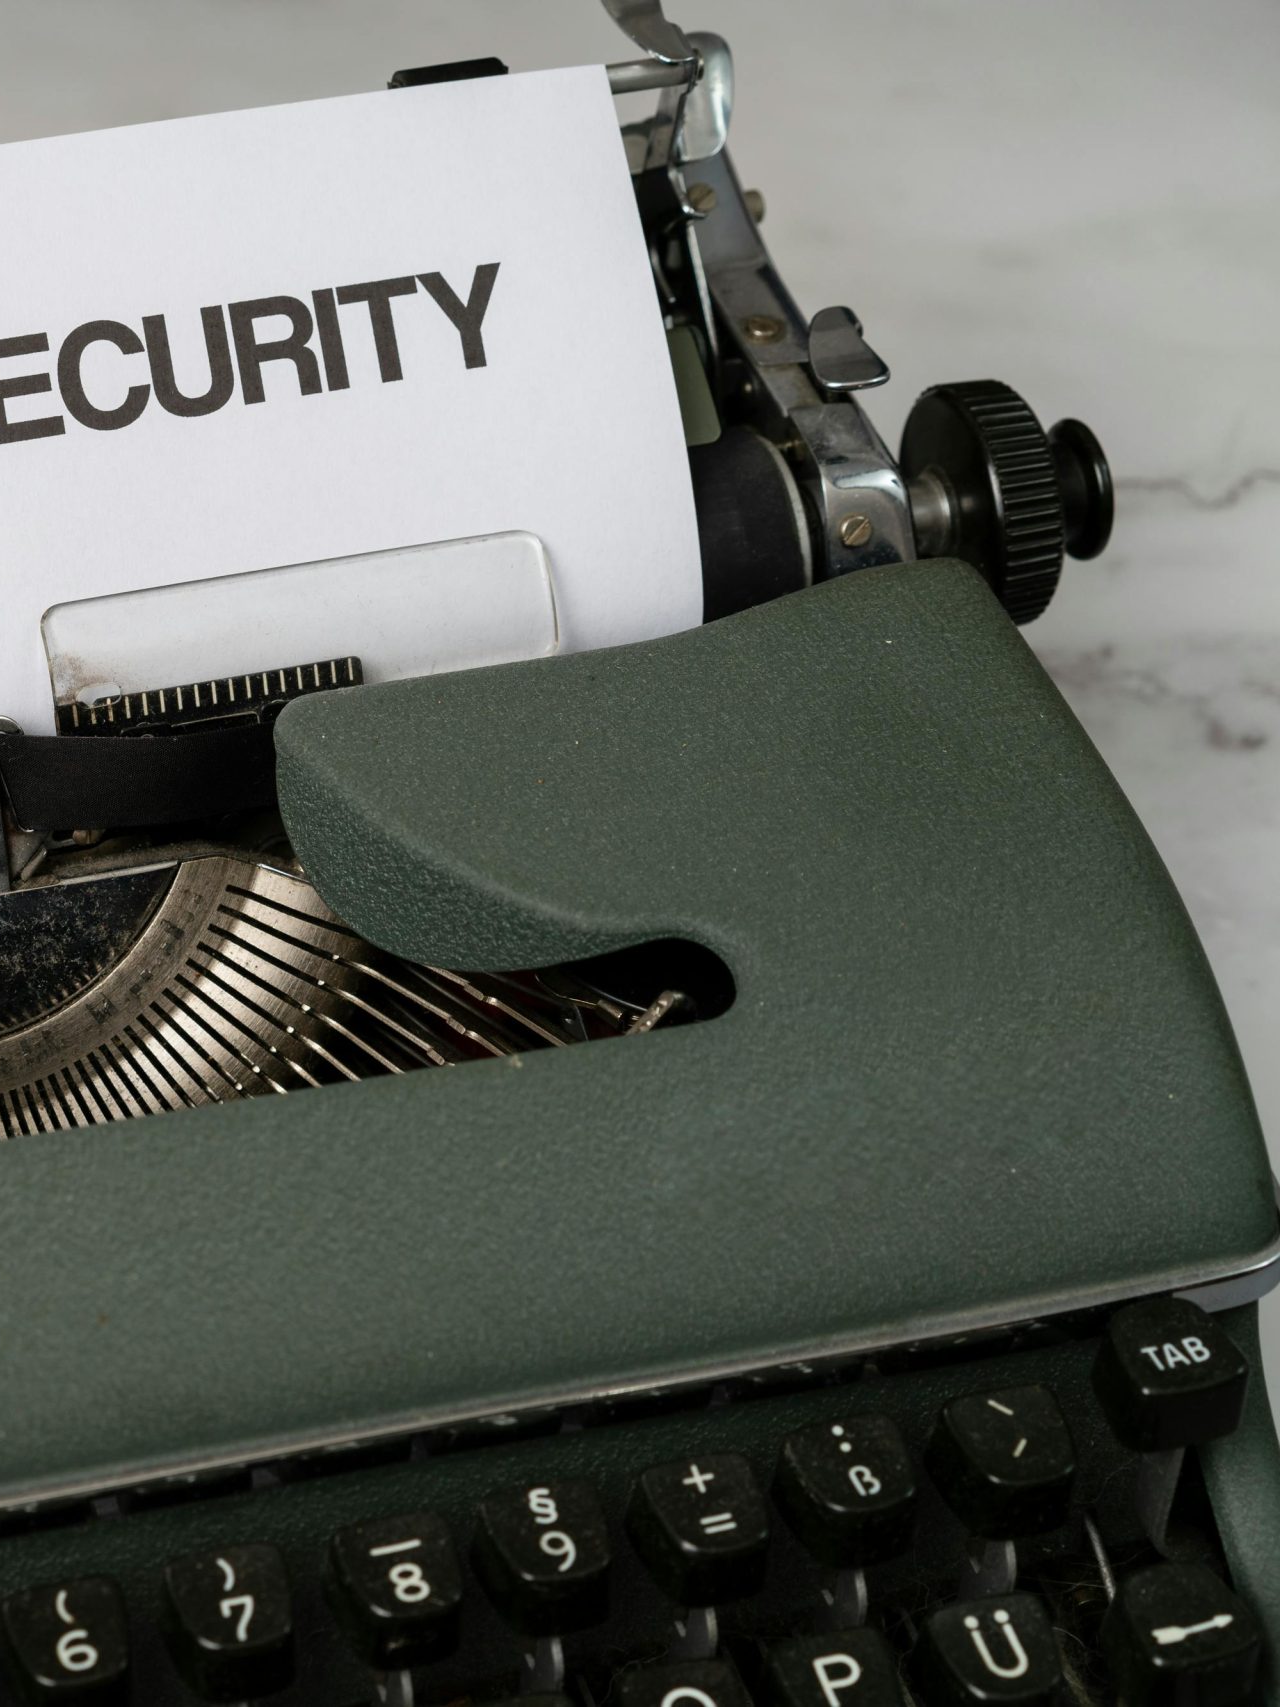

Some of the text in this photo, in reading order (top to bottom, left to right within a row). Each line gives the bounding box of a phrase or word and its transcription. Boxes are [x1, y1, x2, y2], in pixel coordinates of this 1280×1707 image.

[1141, 1336, 1210, 1371] TAB
[682, 1464, 714, 1493] +
[699, 1512, 737, 1534] =
[539, 1531, 577, 1572] 9
[388, 1562, 430, 1602] 8
[220, 1595, 254, 1641] 7
[55, 1629, 99, 1671] 6
[963, 1609, 1029, 1679] Ü
[812, 1653, 862, 1707] P
